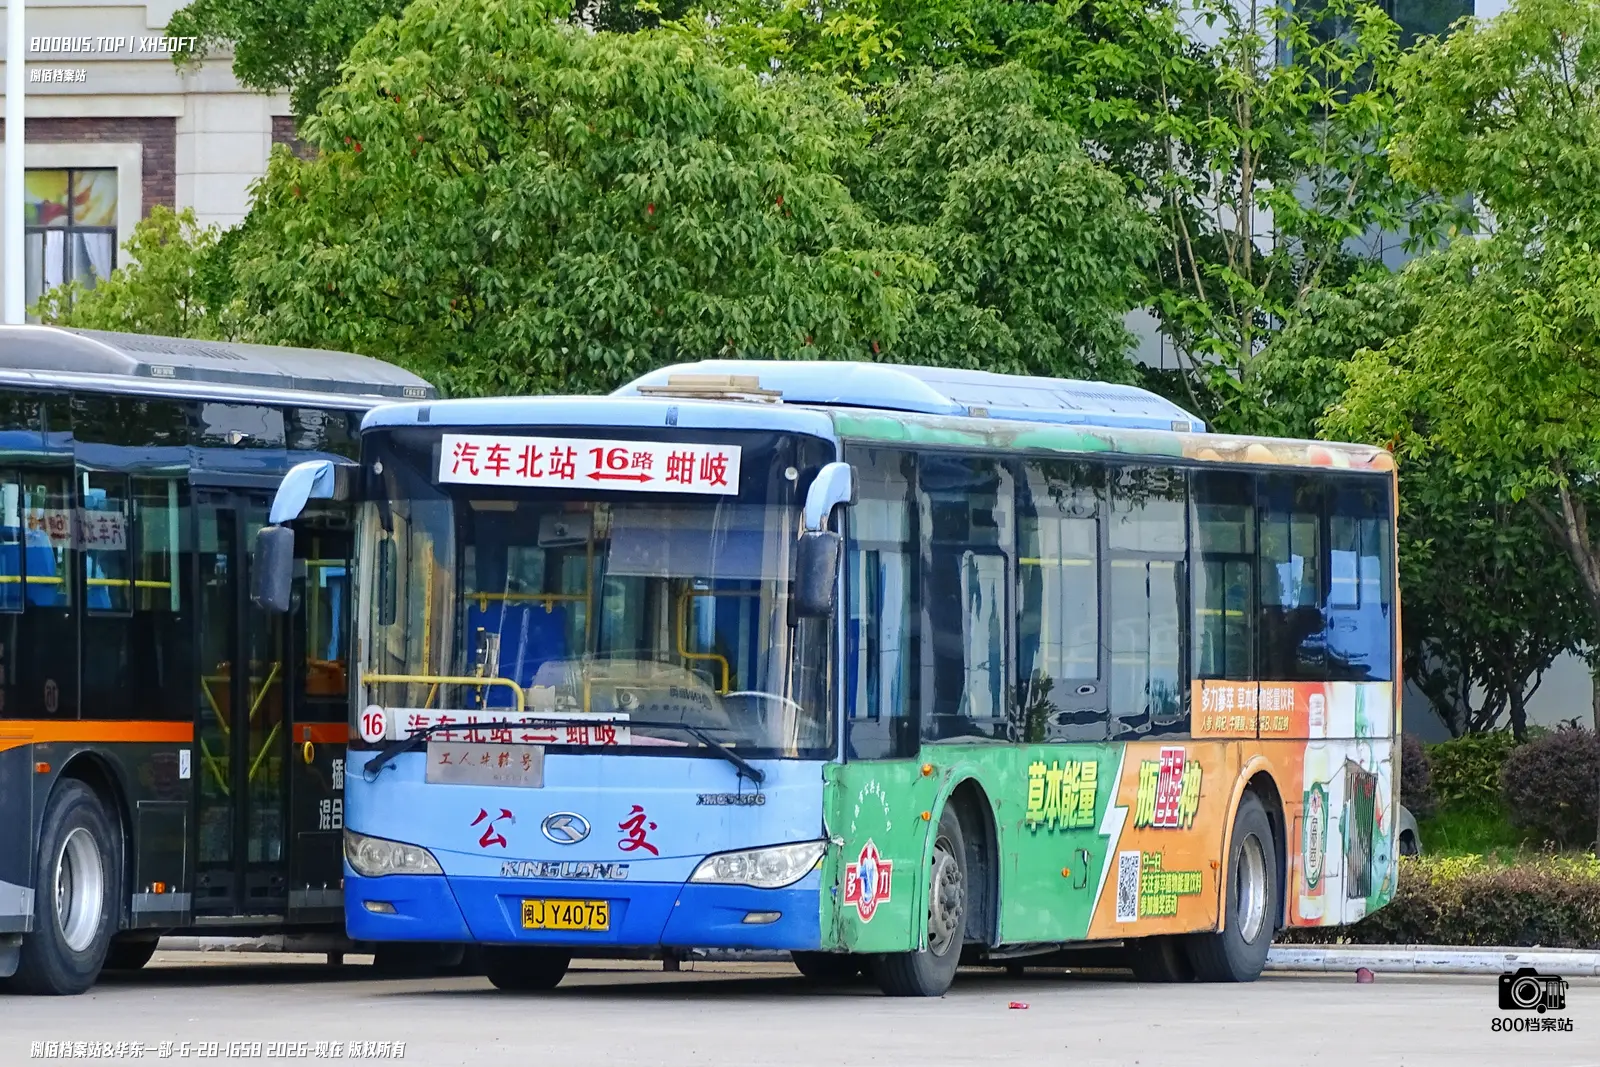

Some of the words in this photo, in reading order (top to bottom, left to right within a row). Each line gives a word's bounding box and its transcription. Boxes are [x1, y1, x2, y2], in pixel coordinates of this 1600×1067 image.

[452, 442, 577, 480] 汽车北站
[589, 447, 653, 470] 16路
[665, 451, 729, 487] 蚶岐
[363, 713, 383, 736] 16
[1025, 760, 1098, 832] 草本能量
[1134, 746, 1203, 829] 瓶醒神
[319, 798, 343, 830] 混合
[470, 808, 513, 848] 公
[617, 804, 659, 856] 交
[847, 871, 856, 898] 多
[880, 869, 889, 894] 力
